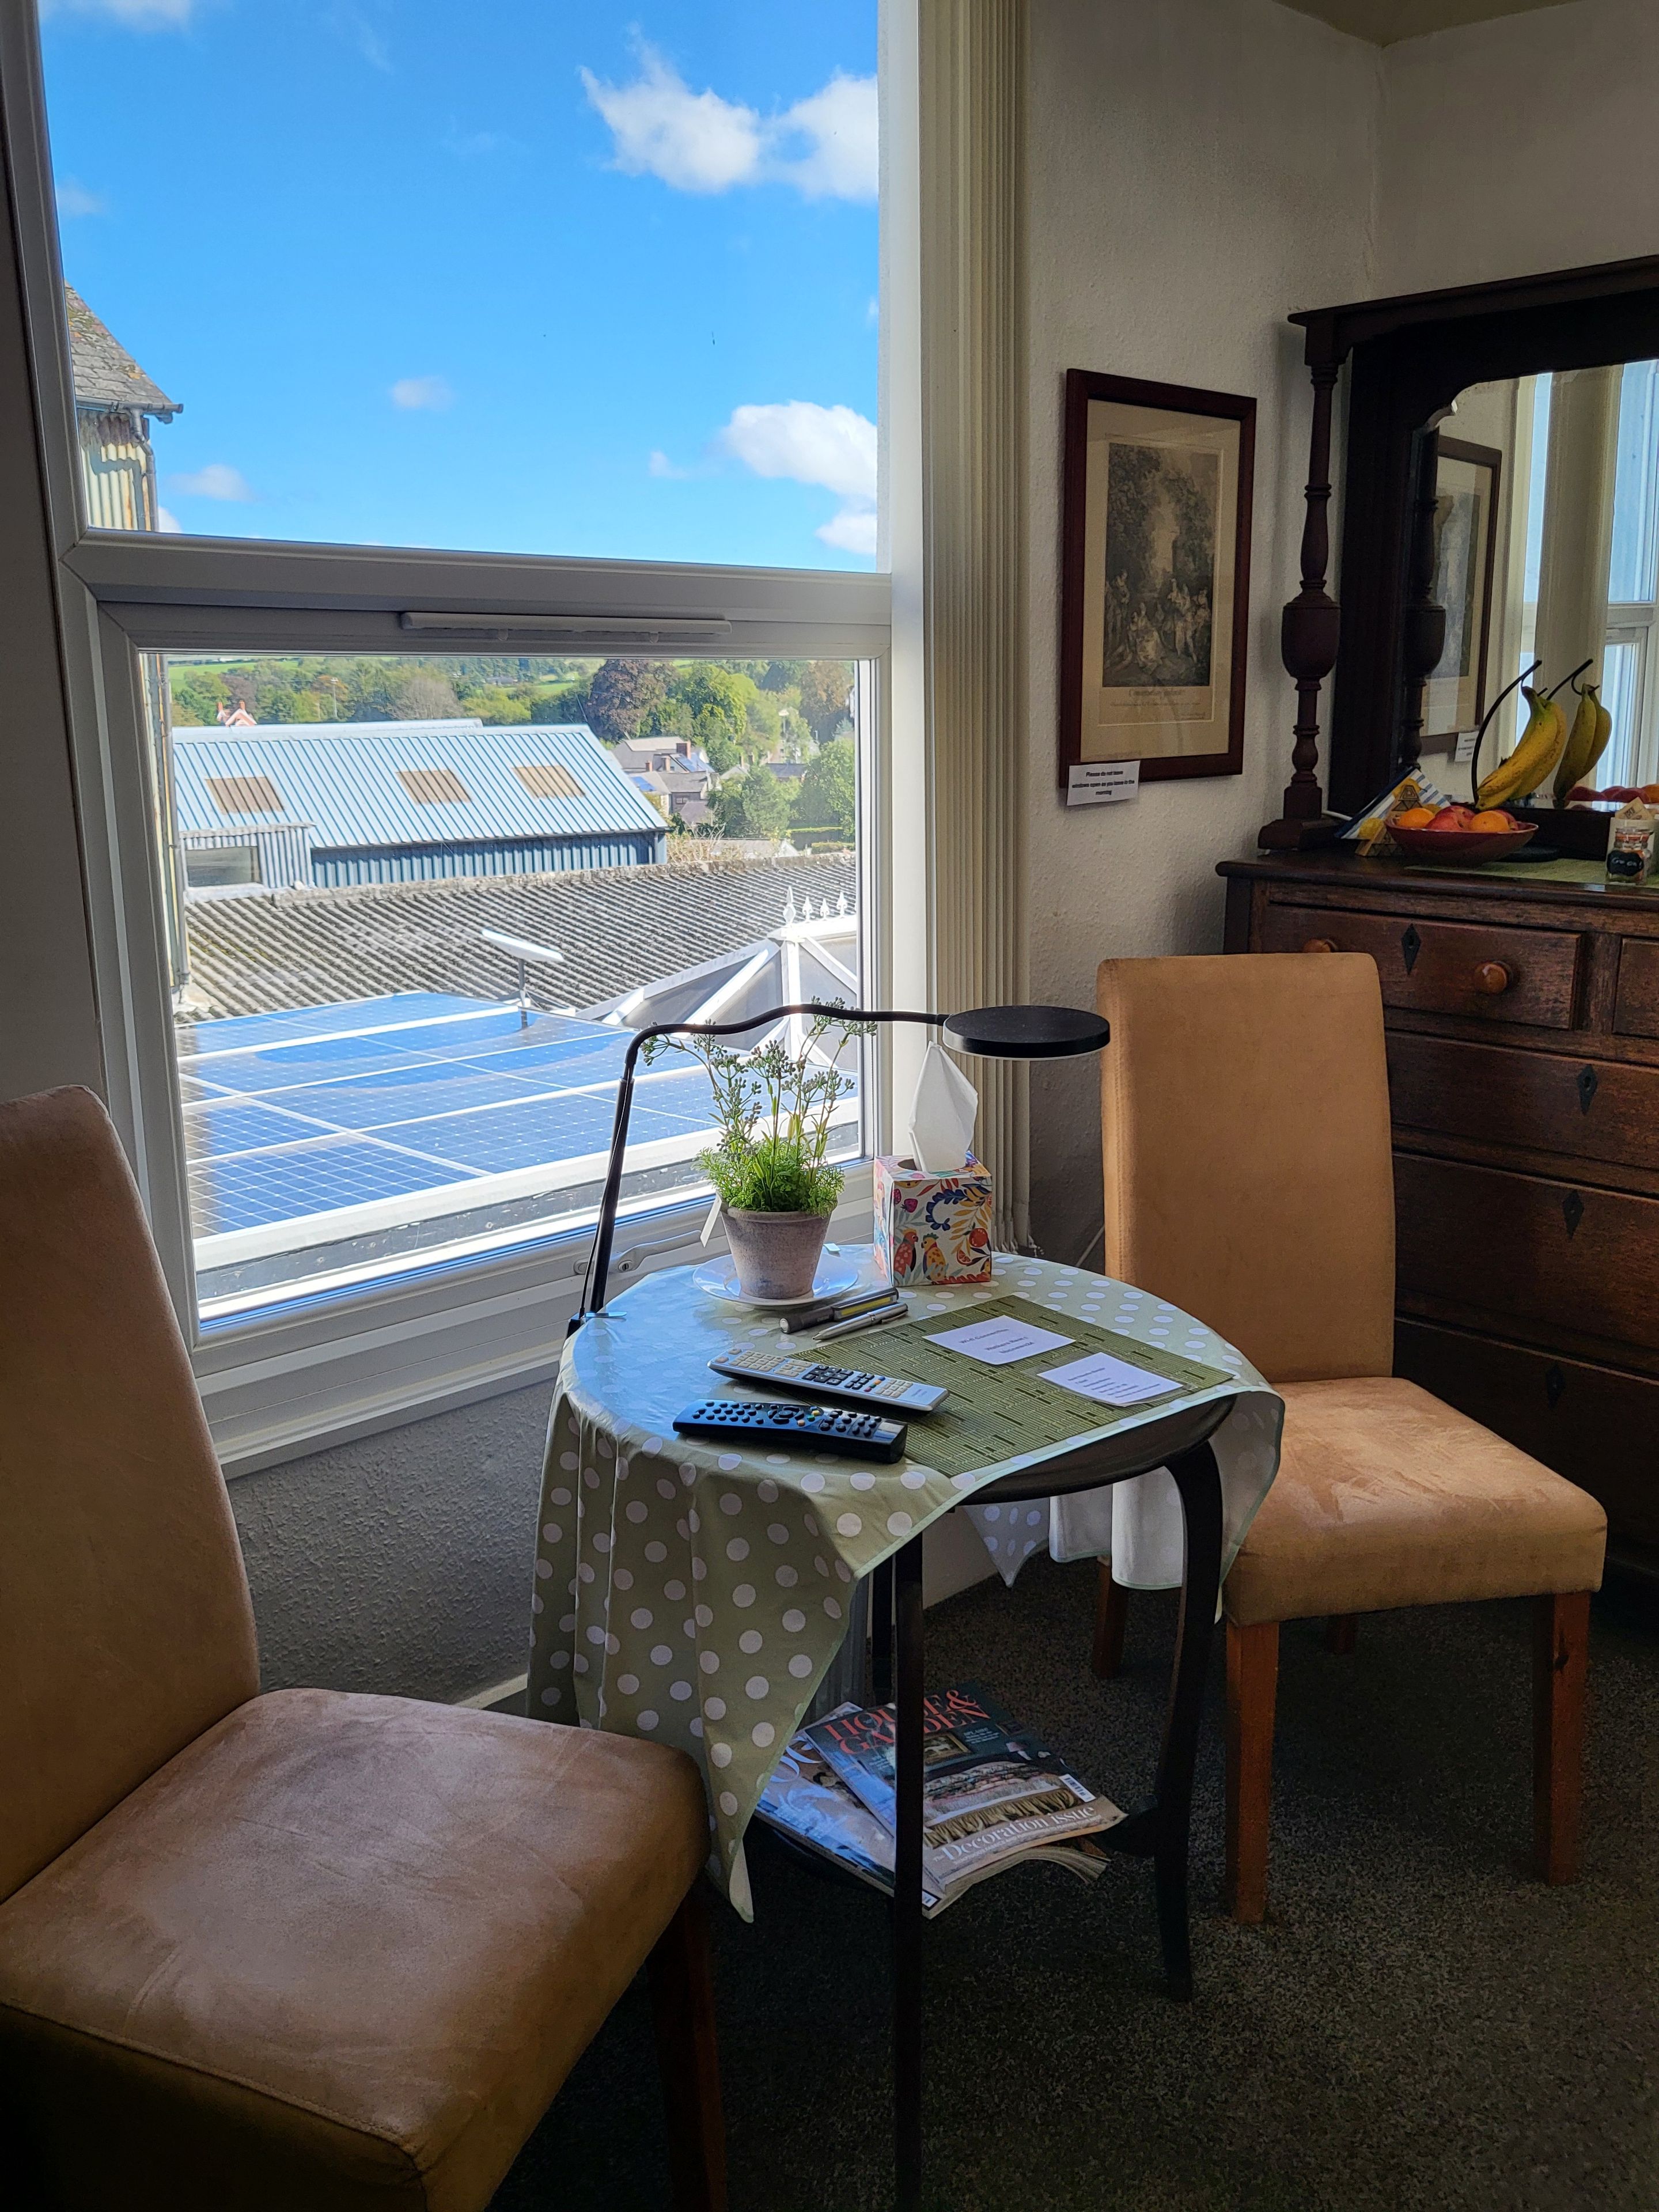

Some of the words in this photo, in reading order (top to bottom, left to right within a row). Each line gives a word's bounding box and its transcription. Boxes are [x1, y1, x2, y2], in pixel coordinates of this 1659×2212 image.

[824, 1694, 953, 1741] HOE
[946, 1689, 978, 1709] &
[839, 1703, 991, 1755] GADEN
[941, 1818, 1049, 1861] Decoration
[1047, 1806, 1096, 1825] issue
